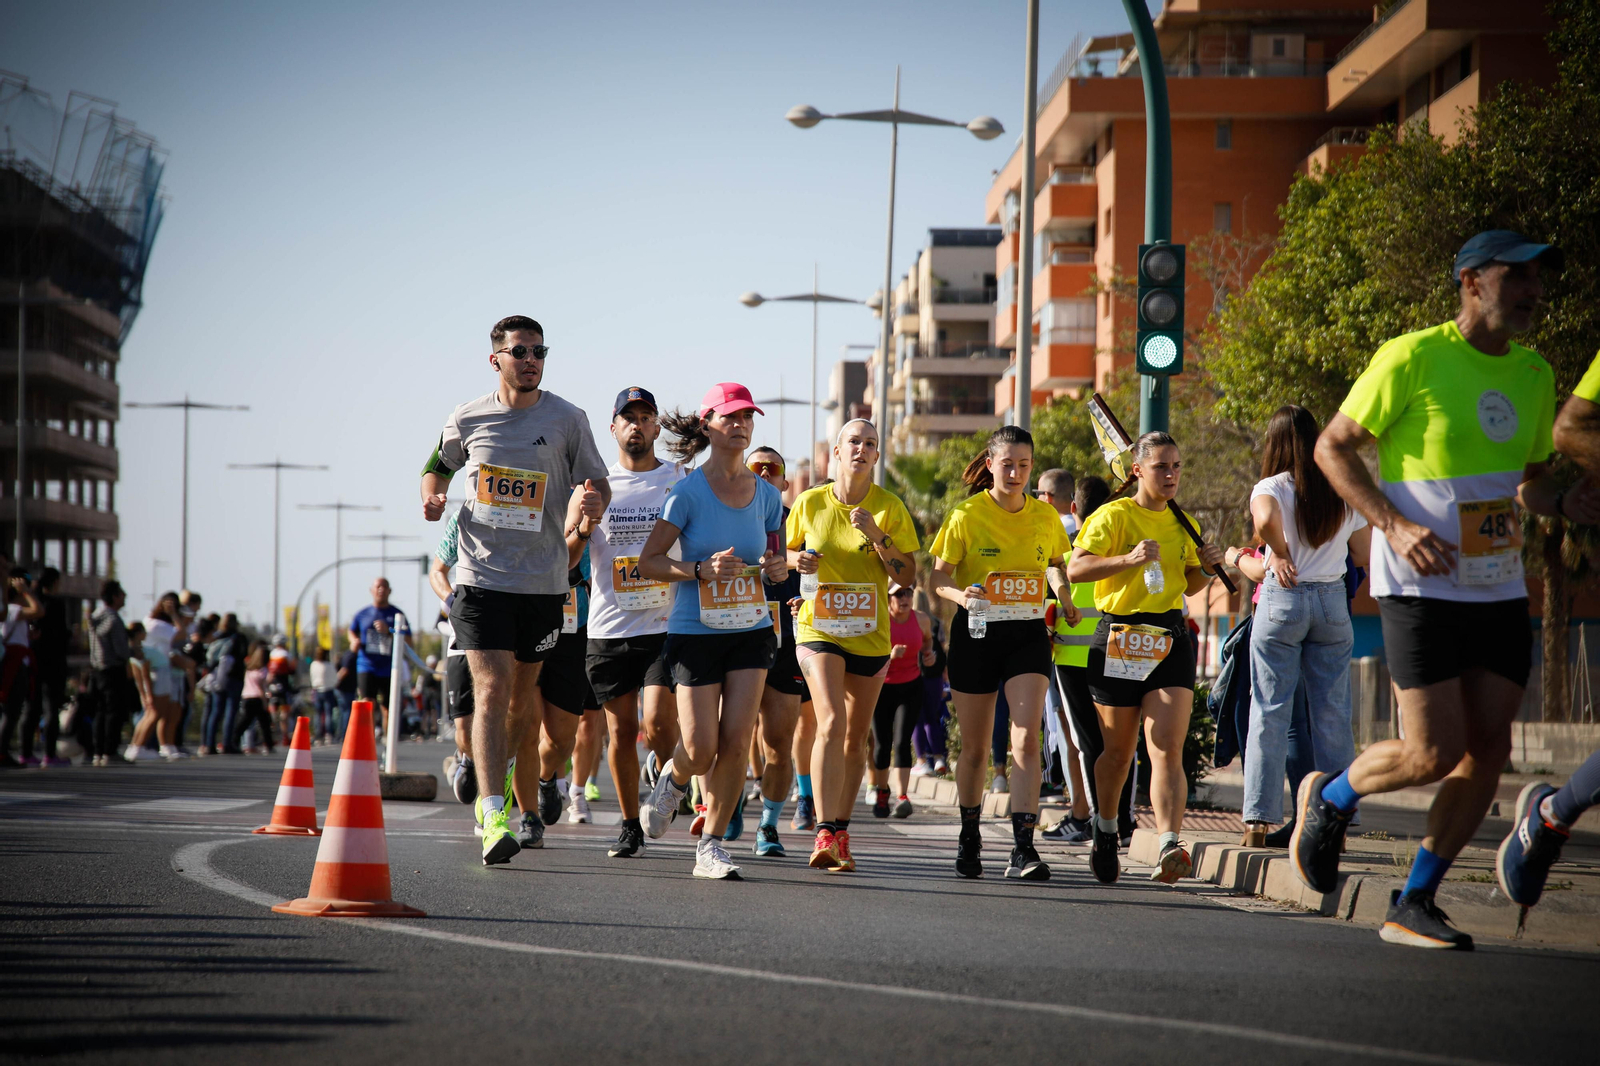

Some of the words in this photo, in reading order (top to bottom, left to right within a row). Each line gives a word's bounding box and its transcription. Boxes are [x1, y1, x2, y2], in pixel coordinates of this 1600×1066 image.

[485, 475, 537, 499] 1661
[494, 495, 523, 503] OUSSAMA
[608, 513, 647, 523] Almería
[1478, 512, 1512, 538] 48
[618, 565, 648, 582] 14
[707, 576, 756, 597] 1701
[991, 578, 1039, 596] 1993
[821, 592, 871, 610] 1992
[1115, 631, 1168, 653] 1994
[1125, 649, 1155, 657] ESTEFANIA
